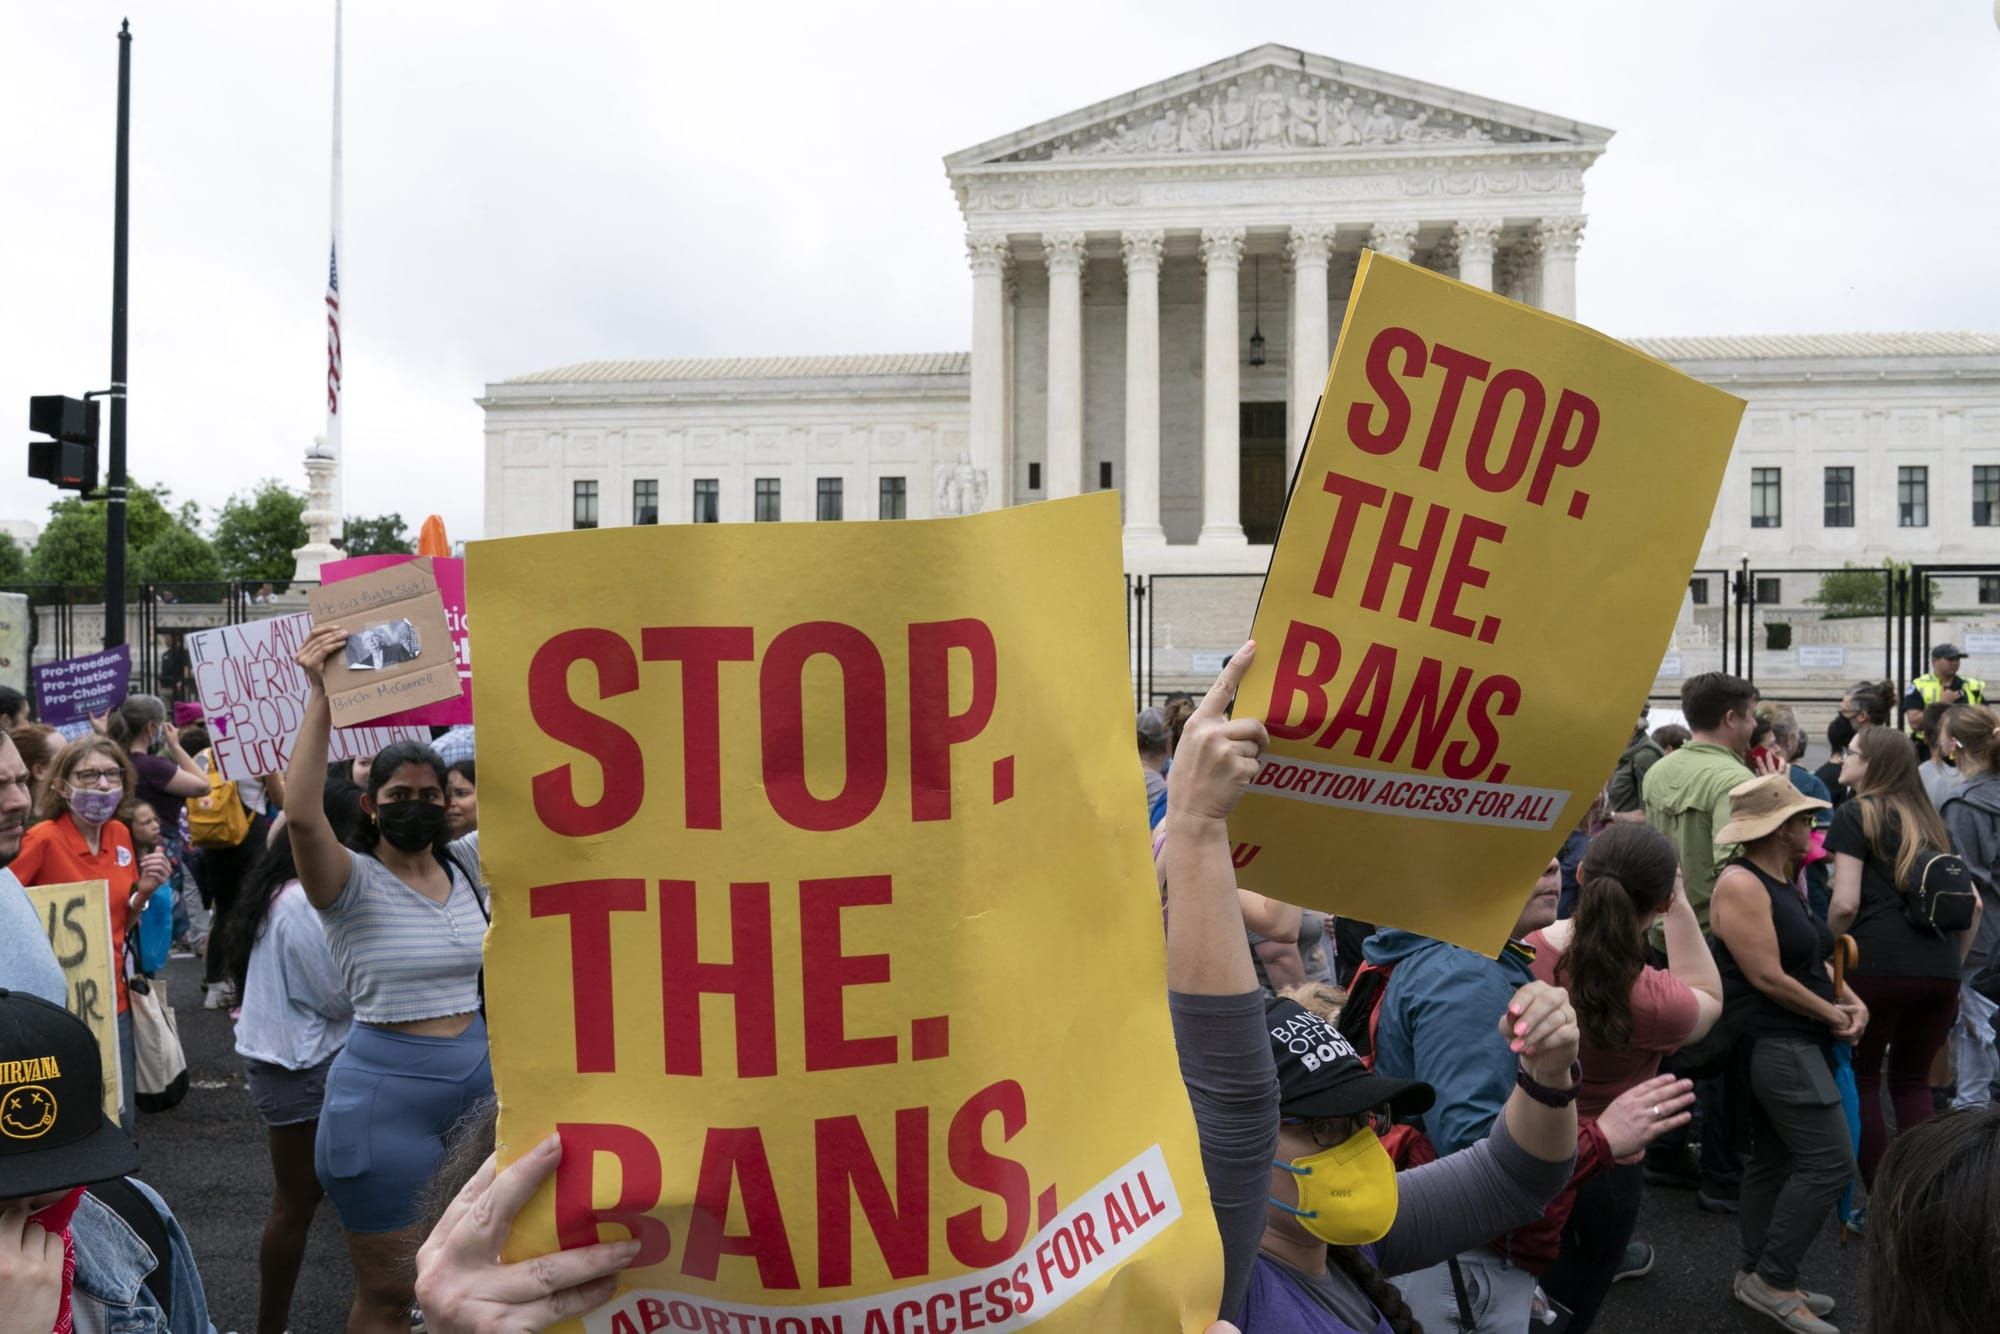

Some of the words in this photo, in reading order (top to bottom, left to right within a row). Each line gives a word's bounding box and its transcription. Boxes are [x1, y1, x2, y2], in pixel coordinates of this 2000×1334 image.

[1347, 327, 1600, 519] STOP.
[1312, 471, 1507, 644] THE.
[41, 653, 123, 679] Pro-Freedom.
[192, 633, 208, 662] IF
[221, 630, 230, 656] I
[43, 668, 117, 693] Pro-Justice.
[45, 682, 116, 706] Pro-Choice.
[1263, 620, 1521, 784] BANS.
[230, 688, 307, 745] BODY
[529, 617, 1013, 835] STOP.
[214, 736, 289, 781] FUCK
[1249, 761, 1376, 803] BORTION
[1371, 780, 1469, 815] ACCESS
[1465, 790, 1516, 819] FOR
[1511, 796, 1554, 822] ALL
[530, 876, 949, 1077] THE.
[1271, 1011, 1325, 1044] BANS
[1289, 1025, 1326, 1055] OFF
[554, 1080, 1058, 1289] BANS.
[863, 1262, 1034, 1334] ACCESS
[1036, 1211, 1104, 1295] FOR
[1104, 1170, 1166, 1245] ALL
